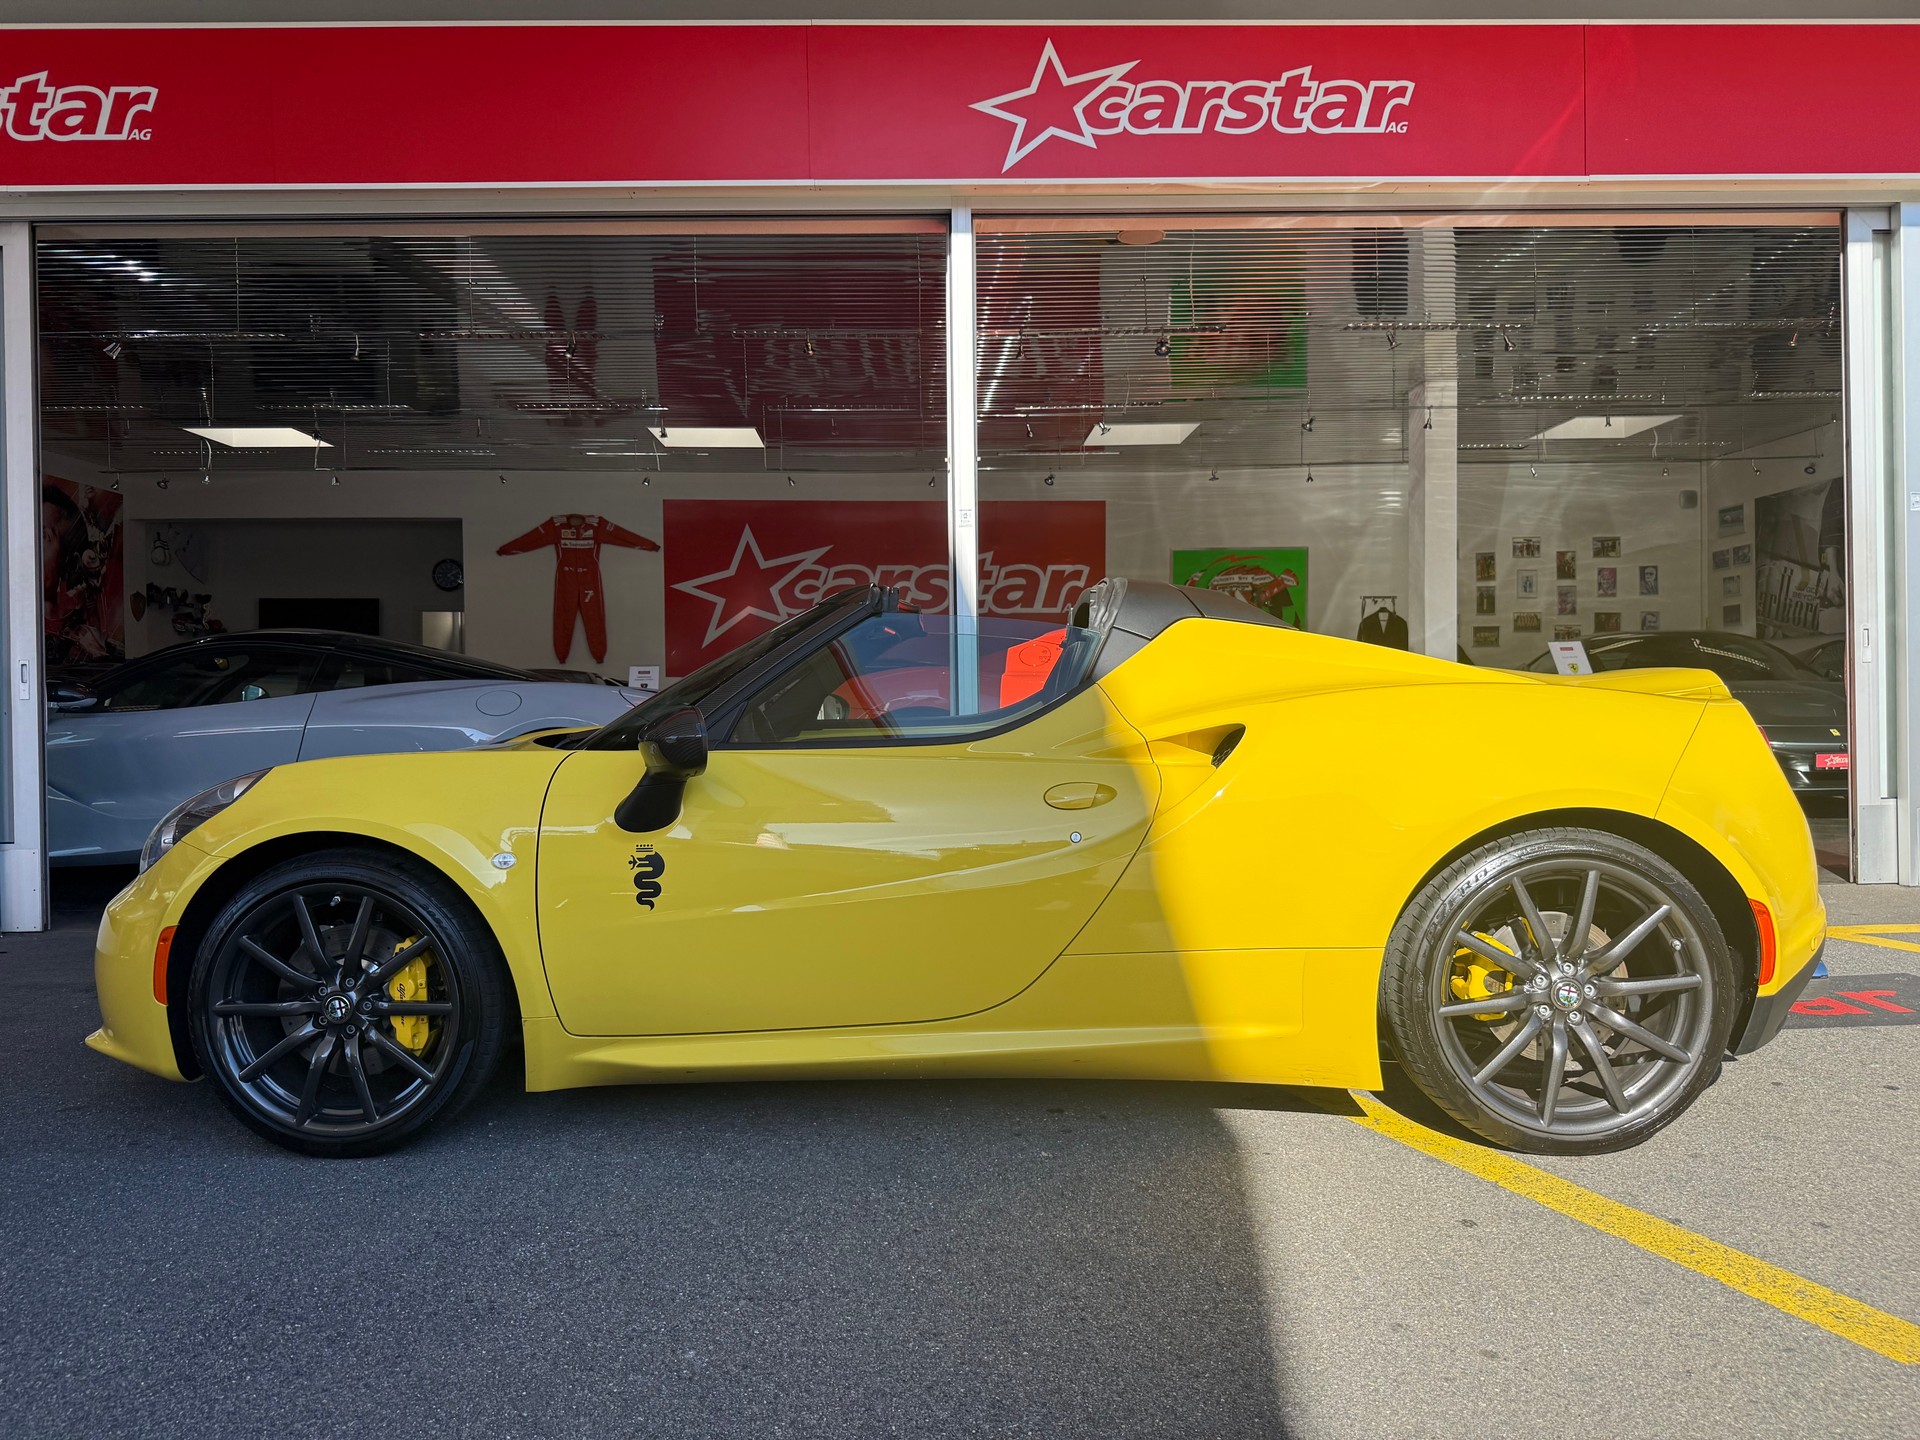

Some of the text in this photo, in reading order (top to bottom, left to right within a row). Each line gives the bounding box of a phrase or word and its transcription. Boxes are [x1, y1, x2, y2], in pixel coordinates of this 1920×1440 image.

[0, 70, 159, 142] tar AG
[1081, 64, 1415, 135] carstar AG
[1789, 989, 1917, 1017] ar
